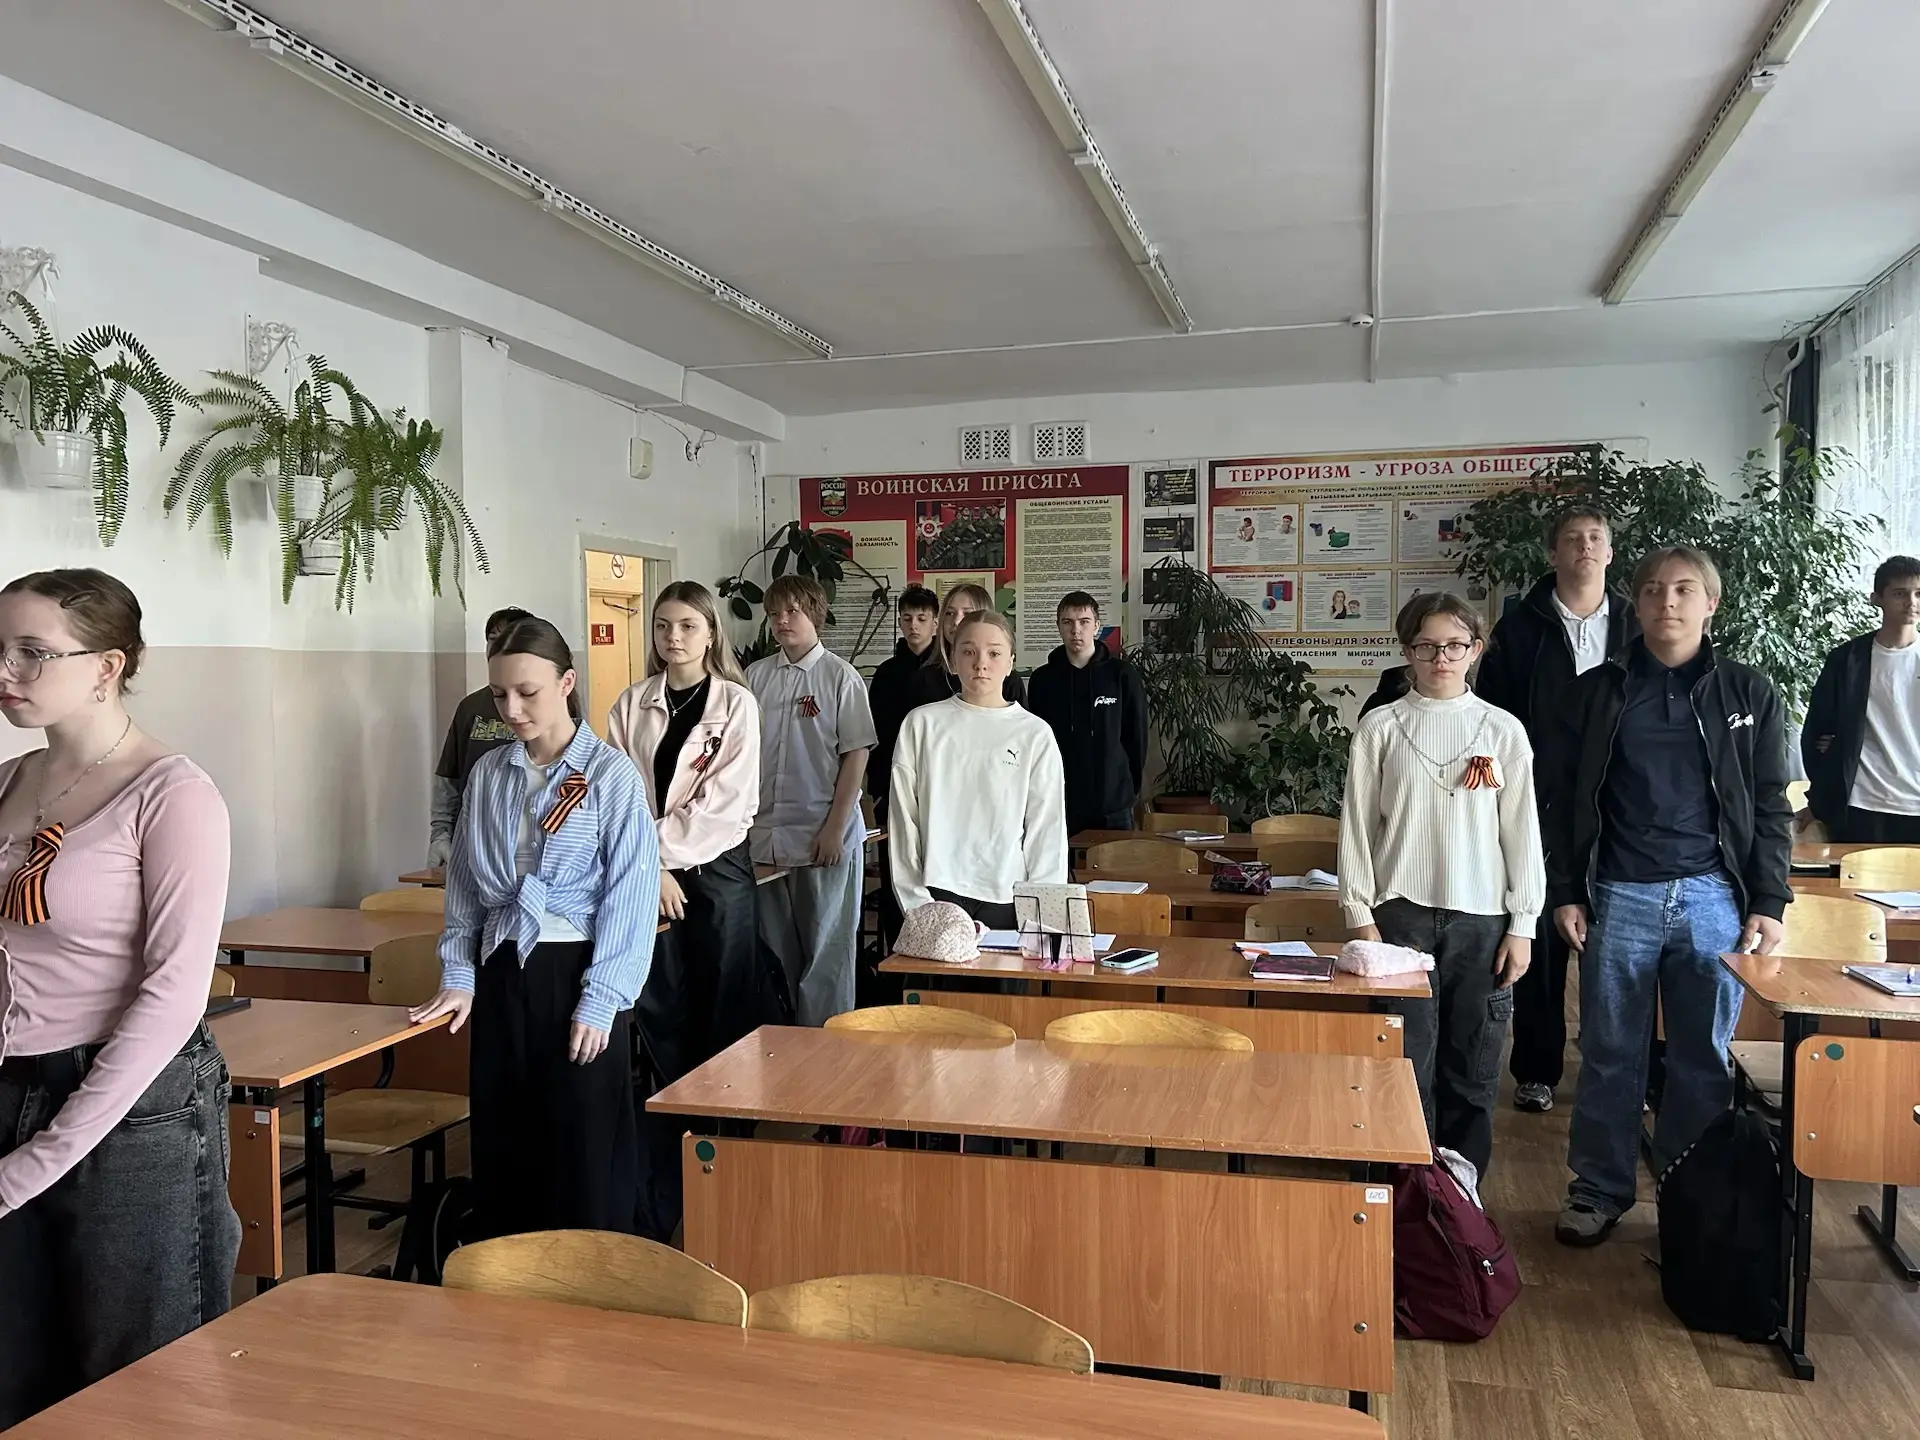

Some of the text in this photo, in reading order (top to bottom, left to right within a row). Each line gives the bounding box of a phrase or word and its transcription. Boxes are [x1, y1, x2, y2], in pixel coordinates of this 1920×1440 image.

[1229, 465, 1351, 482] ТЕРРОРИЗМ
[1375, 461, 1454, 476] УГРОЗА
[1463, 457, 1557, 475] ОБЩЕСТ
[820, 482, 846, 490] РОССИЯ
[857, 472, 1082, 496] ВОИНСКАЯ ПРИСЯГА
[1268, 637, 1399, 645] ТЕЛЕФОНЫ ДЛЯ ЭКСТР
[1347, 650, 1391, 658] МИЛИЦИЯ
[1361, 658, 1374, 666] 02
